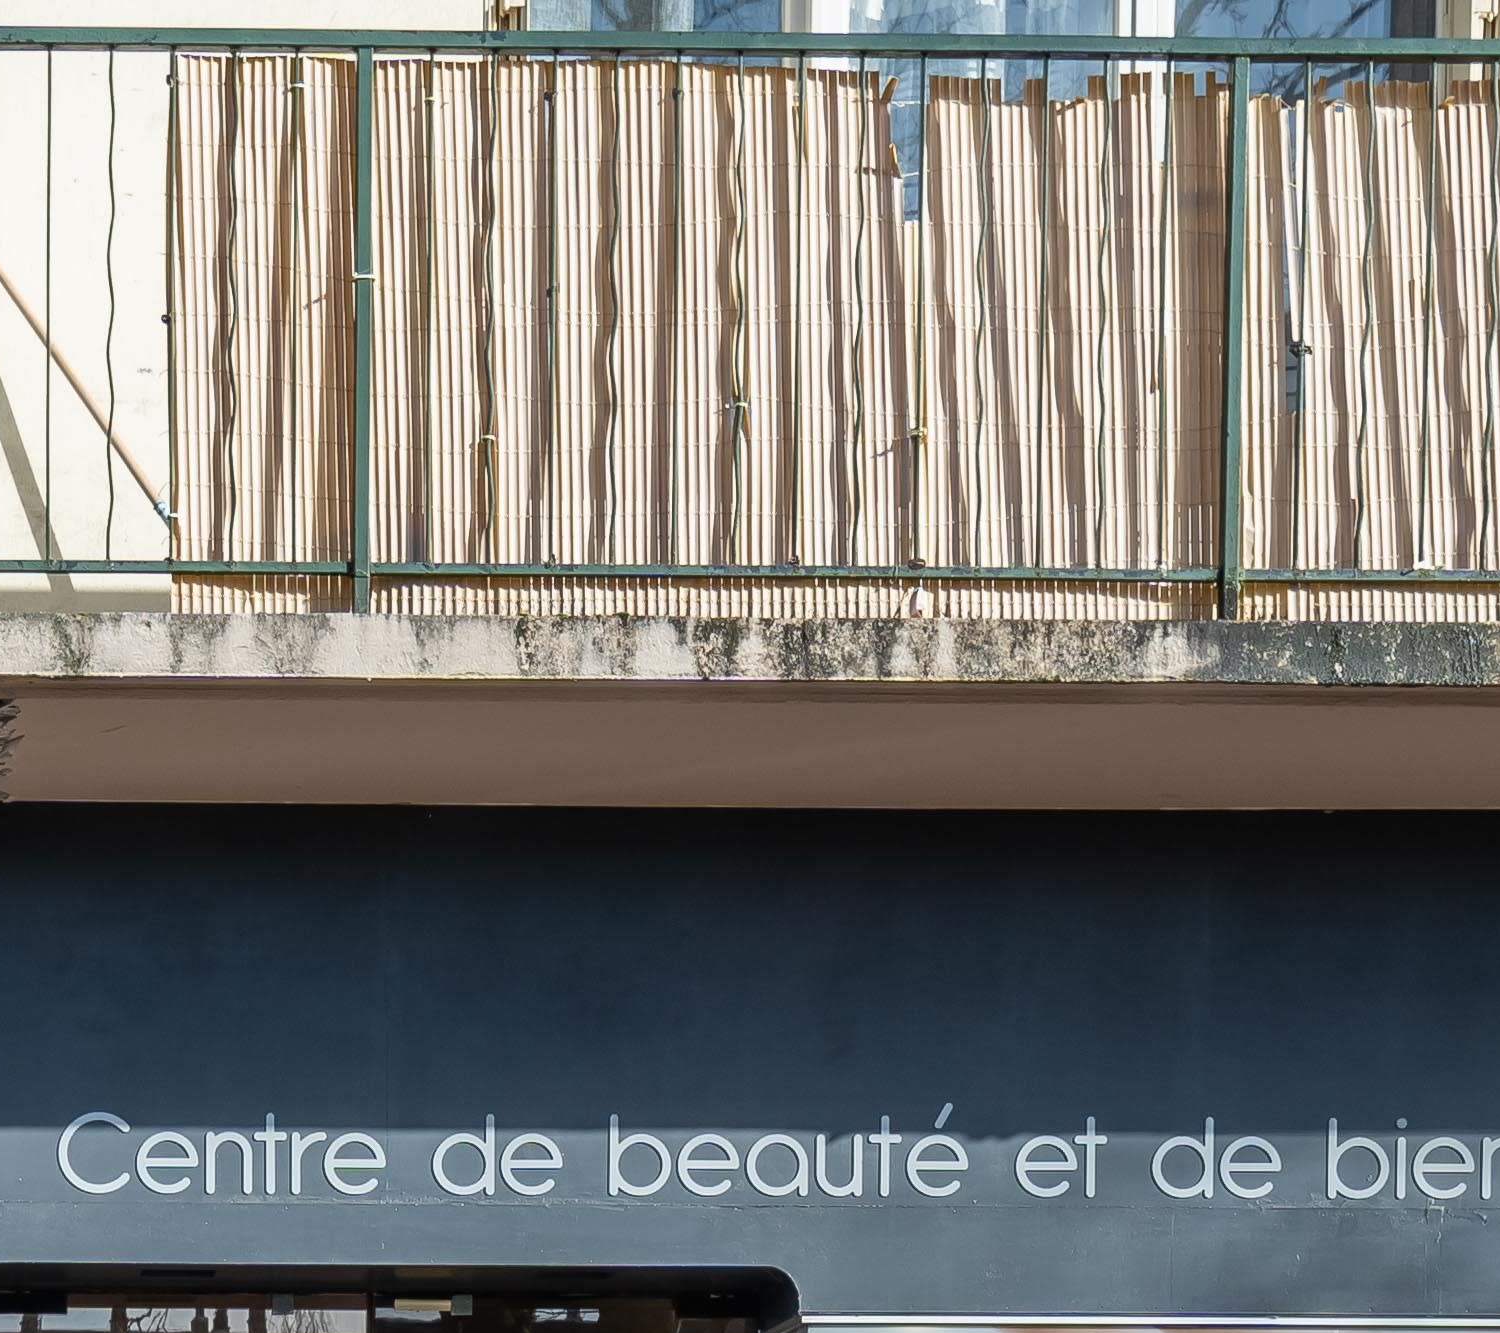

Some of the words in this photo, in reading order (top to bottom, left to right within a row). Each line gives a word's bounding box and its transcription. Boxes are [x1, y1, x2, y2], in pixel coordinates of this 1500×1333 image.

[58, 1111, 387, 1196] Centre
[432, 1112, 563, 1197] de
[609, 1102, 969, 1198] beauté
[1015, 1115, 1108, 1199] et
[1151, 1116, 1282, 1200] de
